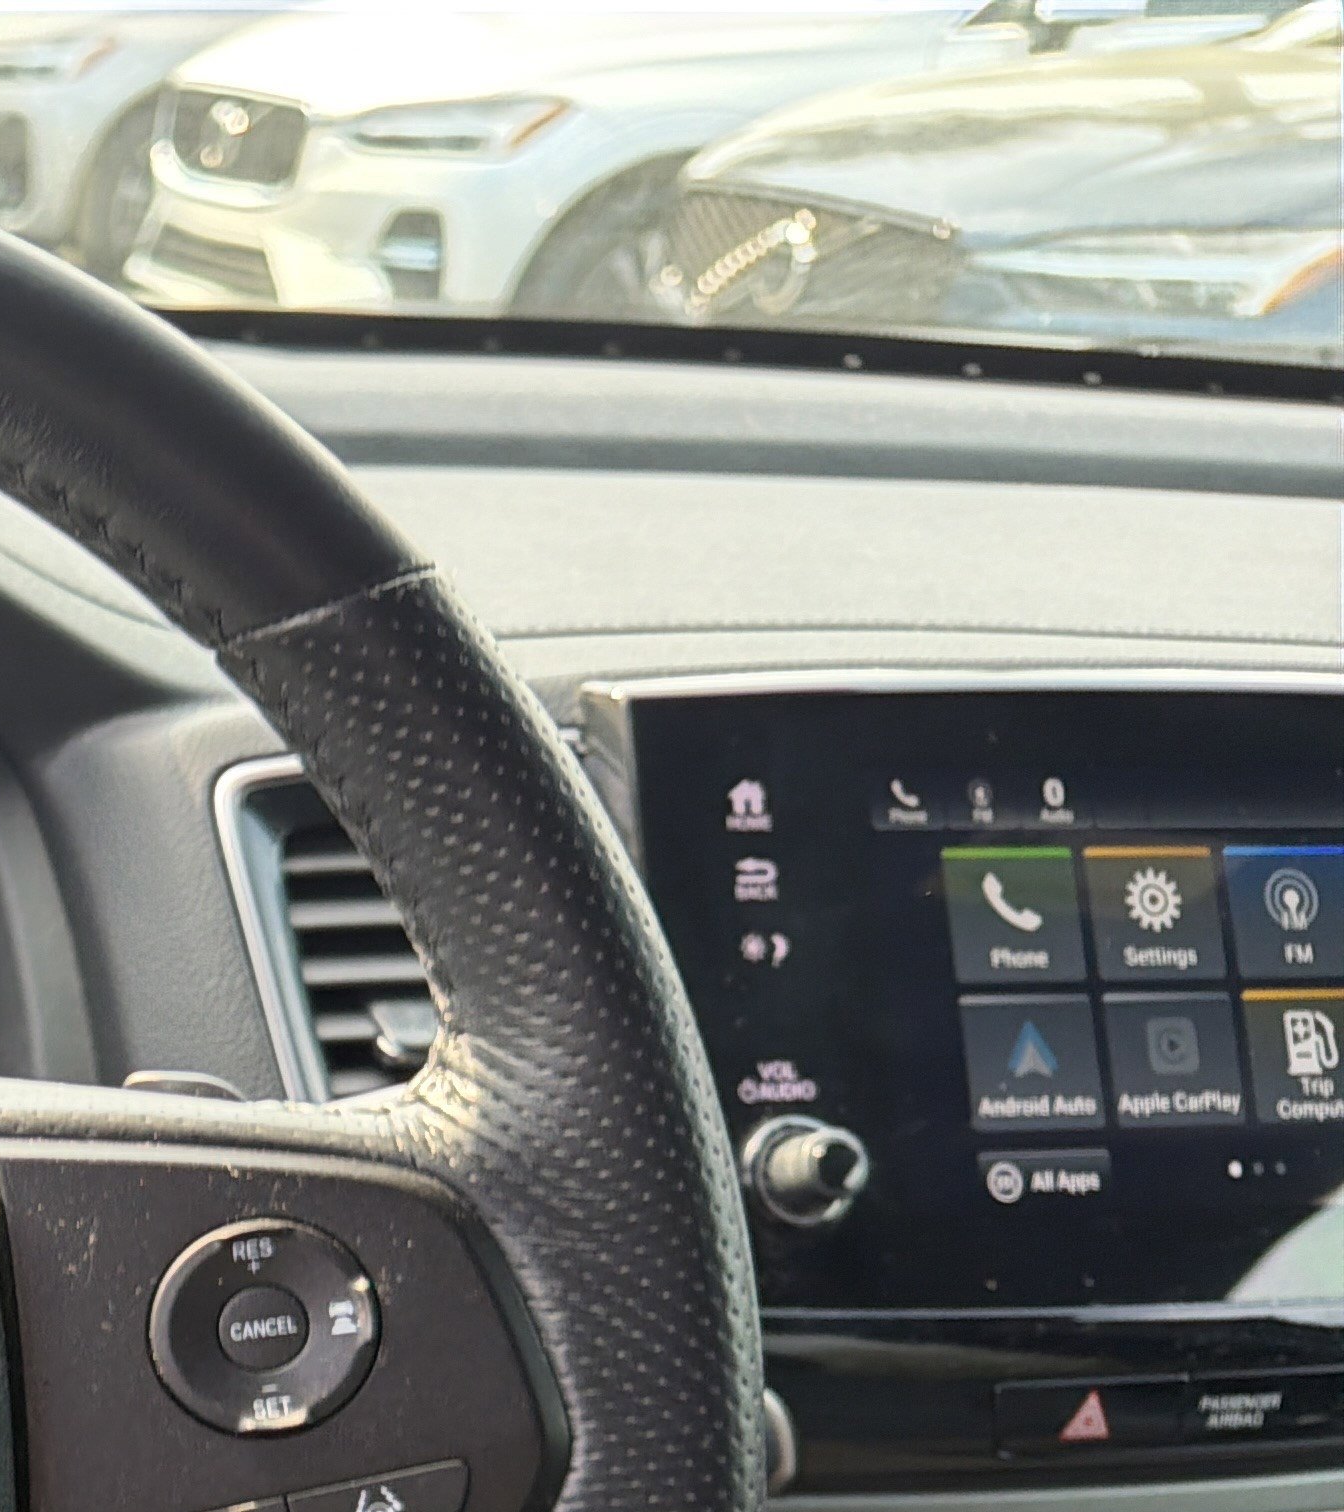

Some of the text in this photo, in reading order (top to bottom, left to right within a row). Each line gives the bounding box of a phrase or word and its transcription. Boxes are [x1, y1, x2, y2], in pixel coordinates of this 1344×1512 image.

[989, 947, 1051, 970] Phone
[1123, 945, 1199, 971] Settings
[1283, 942, 1314, 966] FM
[1299, 1076, 1335, 1098] Trip
[977, 1094, 1097, 1119] Android Auto
[1117, 1089, 1242, 1119] Apple CarPlay
[1030, 1169, 1102, 1196] All Apps
[232, 1238, 273, 1264] RES
[229, 1314, 299, 1344] CANCEL
[252, 1395, 293, 1421] SET
